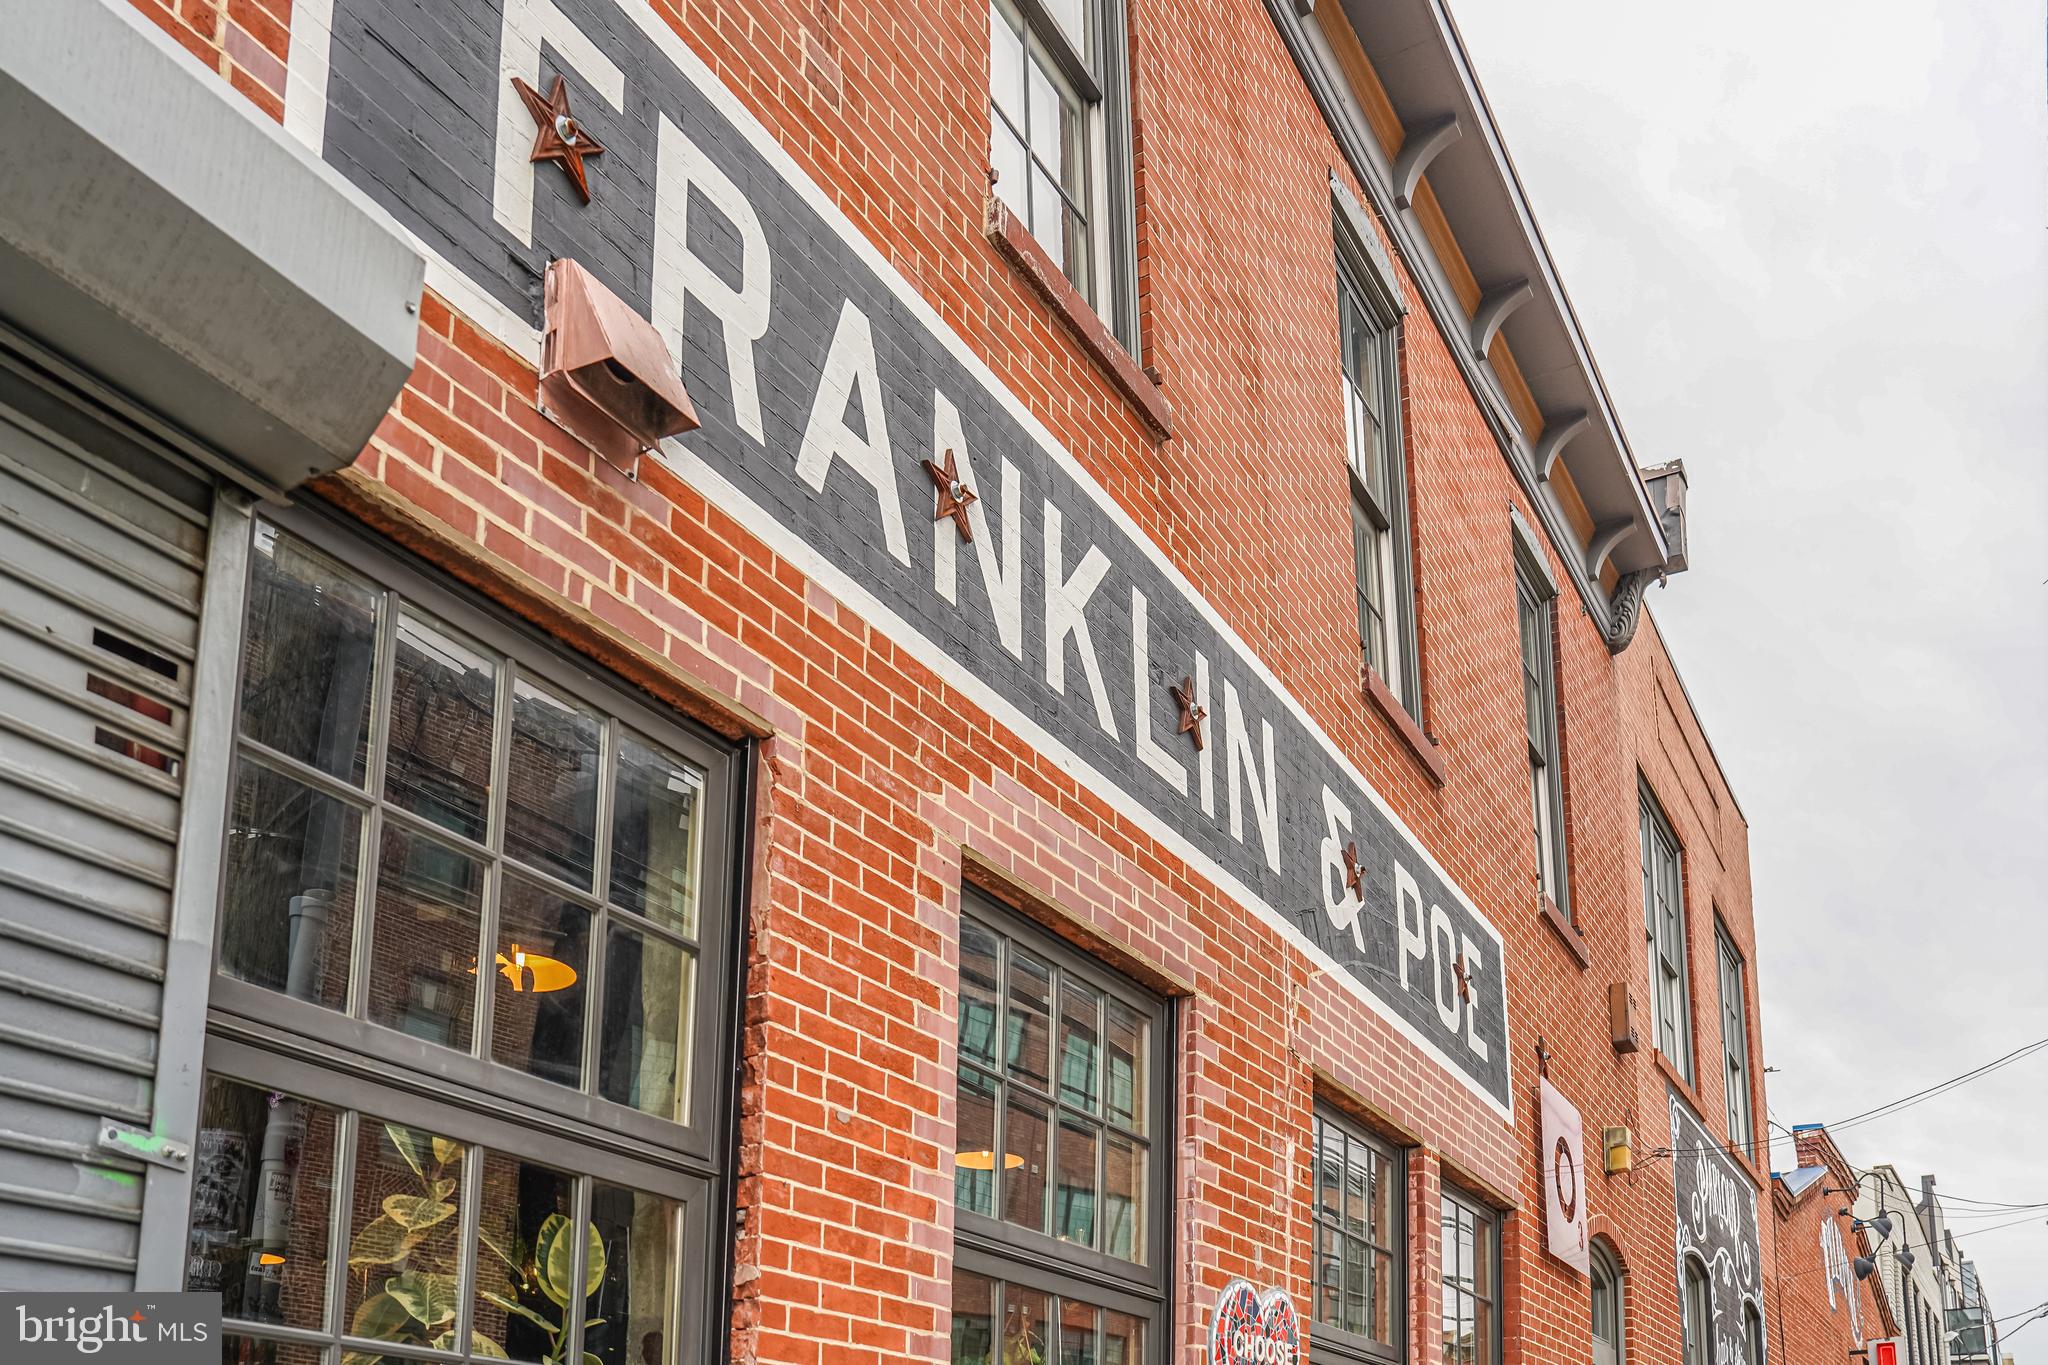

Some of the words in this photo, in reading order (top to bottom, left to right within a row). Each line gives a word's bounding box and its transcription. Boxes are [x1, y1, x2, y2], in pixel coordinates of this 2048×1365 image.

[491, 0, 1281, 876] FRANKLIN
[1321, 783, 1366, 954] &
[1394, 859, 1489, 1063] POE
[1233, 1330, 1297, 1365] CHOOSE
